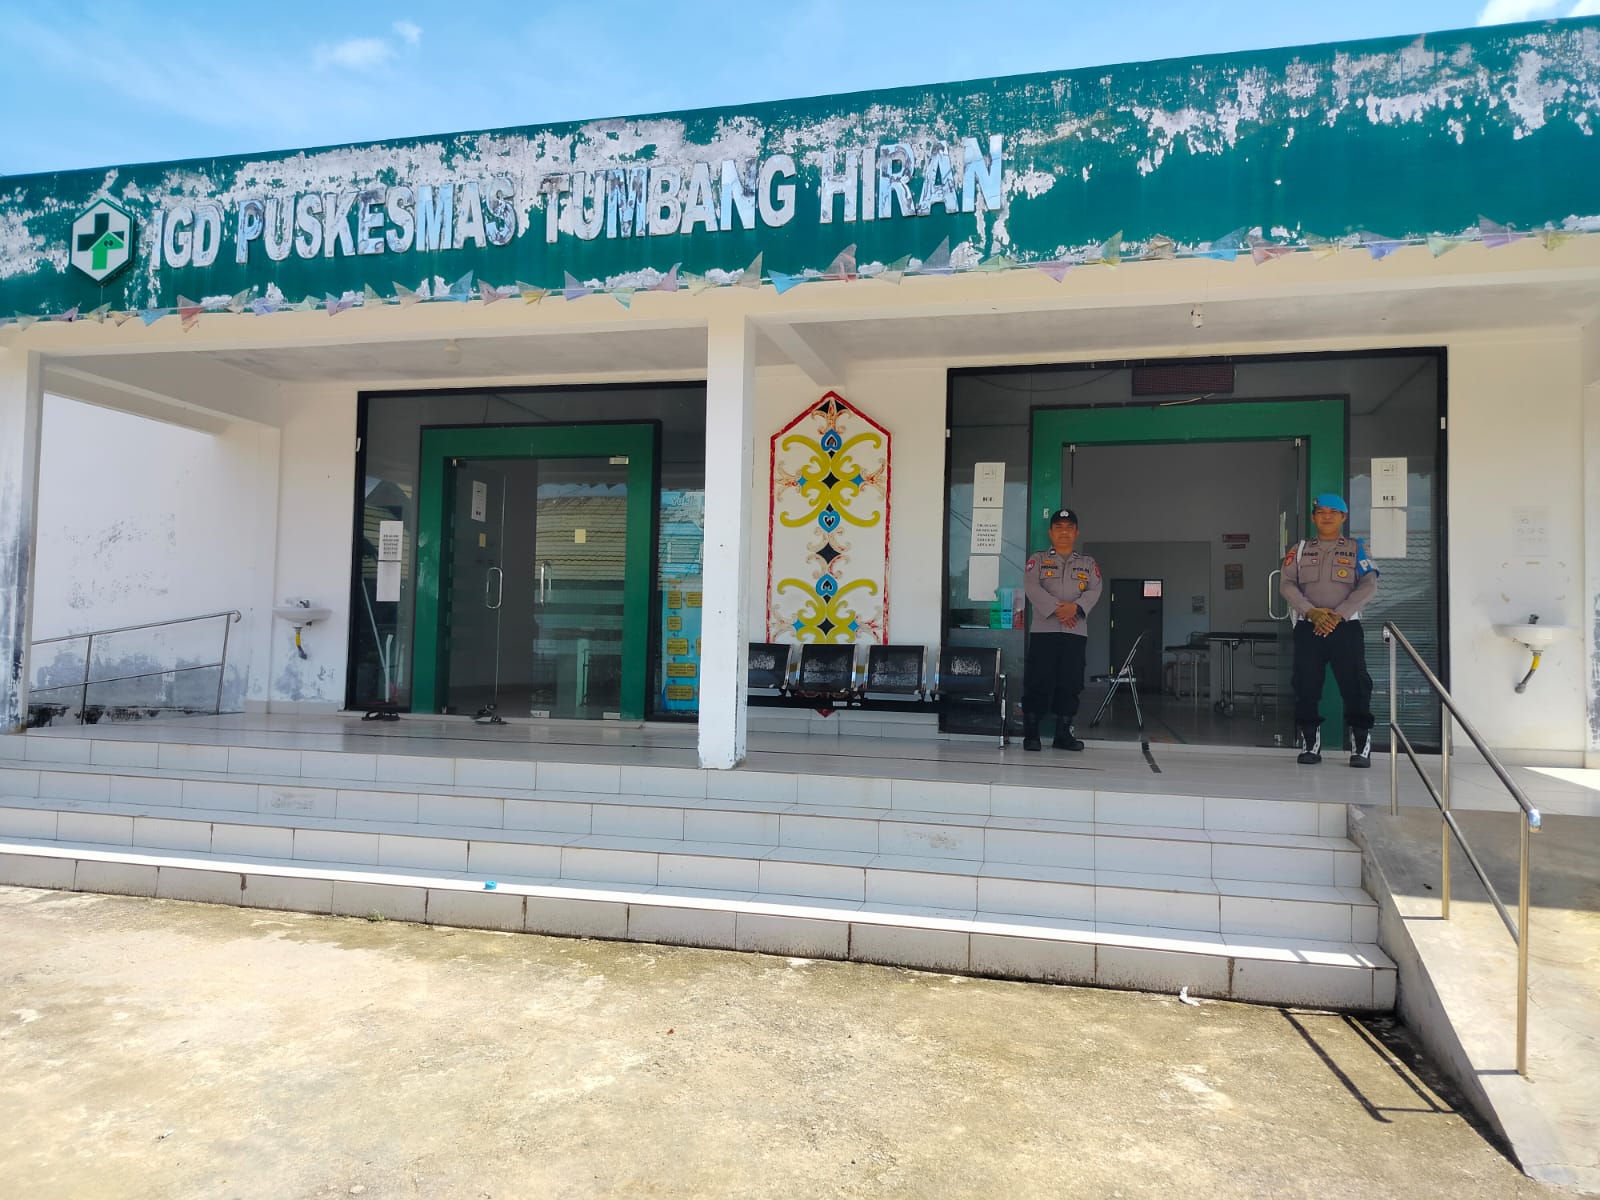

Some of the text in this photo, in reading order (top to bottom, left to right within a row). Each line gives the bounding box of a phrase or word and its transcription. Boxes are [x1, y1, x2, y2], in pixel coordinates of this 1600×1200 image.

[151, 134, 1003, 270] IGD PUSKESMAS TUMBANG HIRAN
